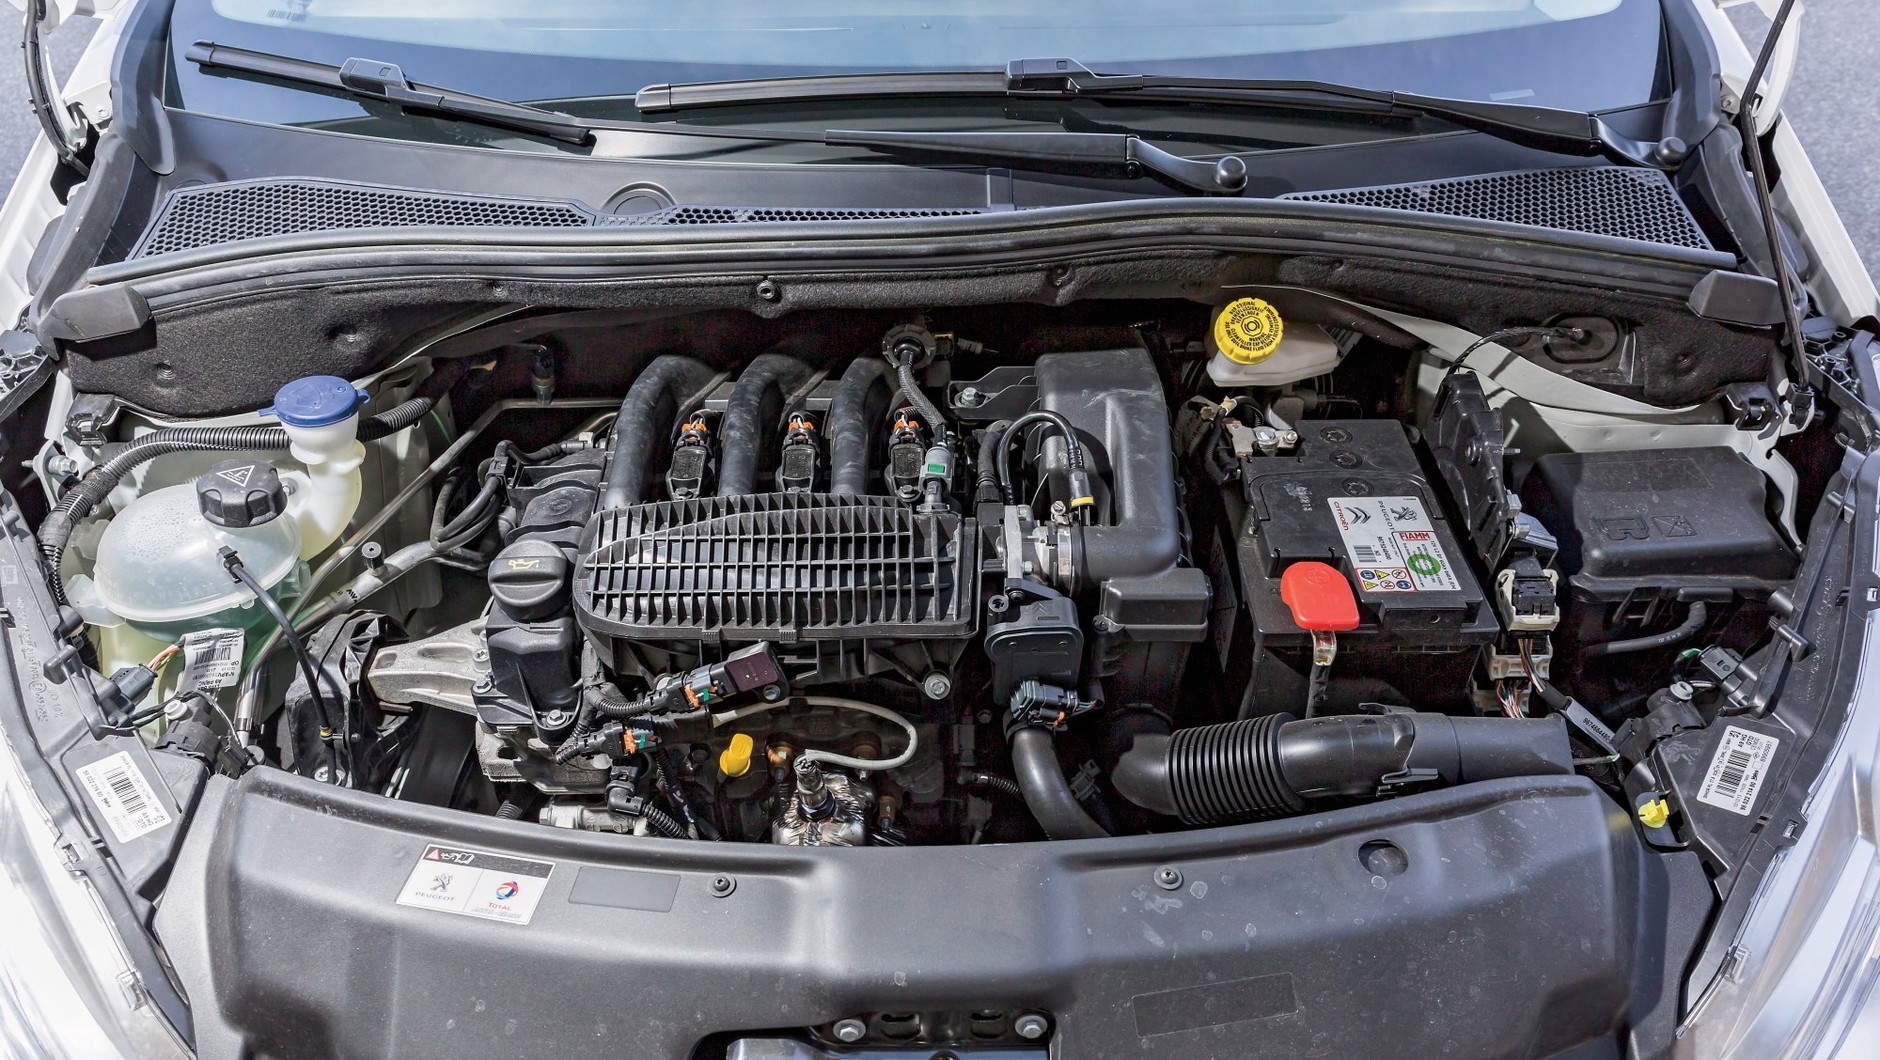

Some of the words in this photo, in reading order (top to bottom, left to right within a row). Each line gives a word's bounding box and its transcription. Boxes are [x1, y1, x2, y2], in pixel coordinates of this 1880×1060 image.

[1378, 501, 1394, 530] PEUGEOT
[1399, 532, 1430, 541] FIAMM
[416, 892, 455, 901] PEUGEOT
[489, 902, 511, 911] TOTAL
